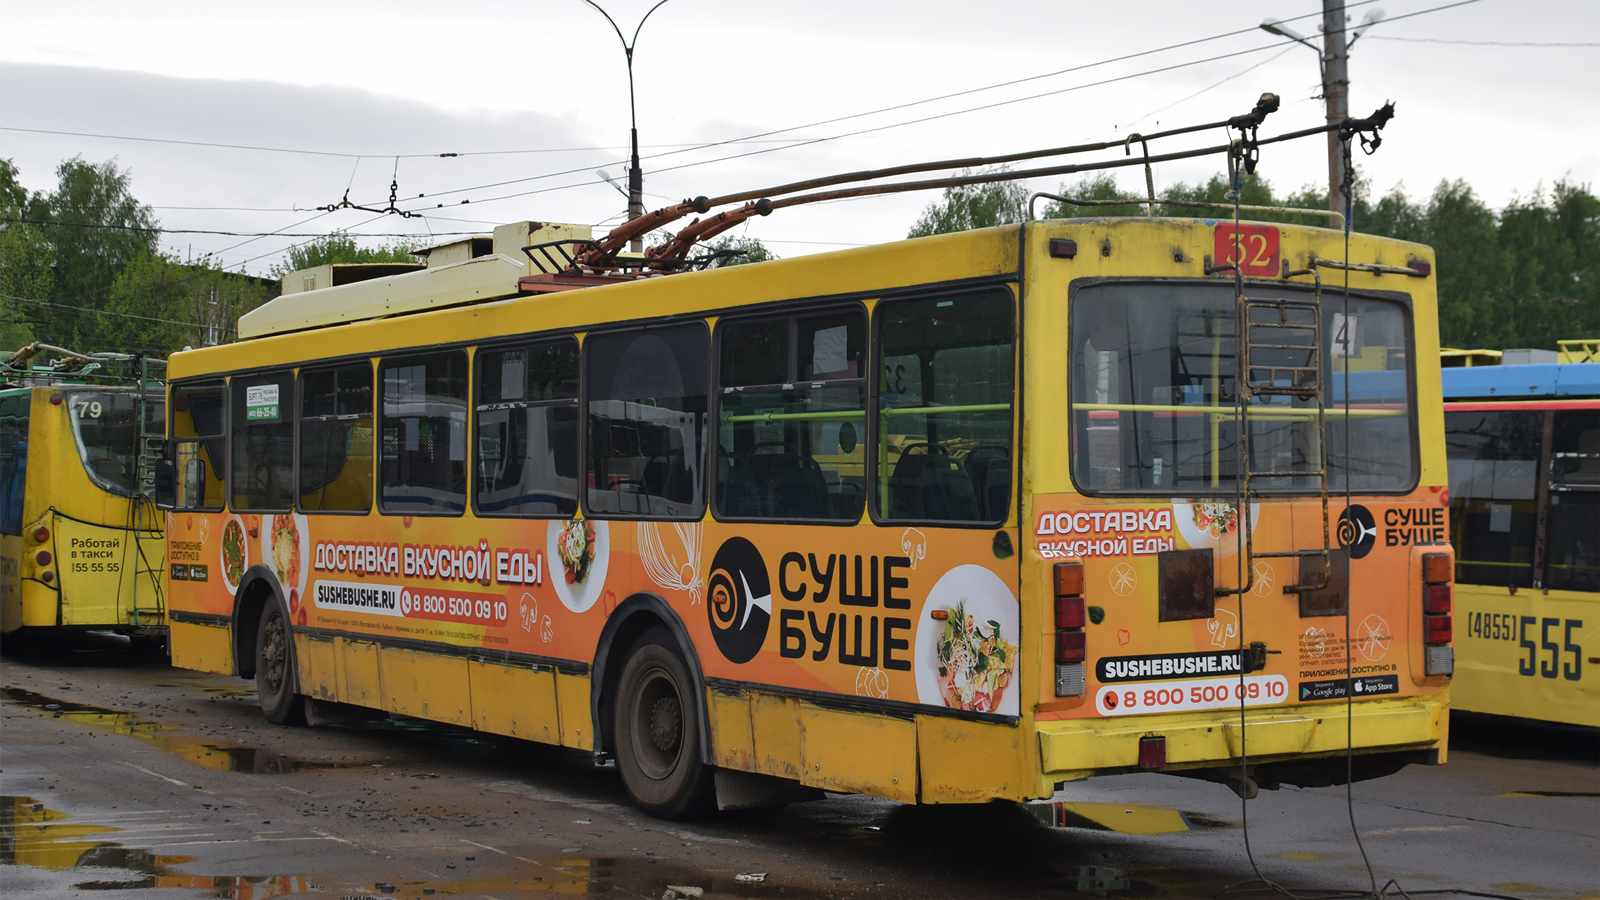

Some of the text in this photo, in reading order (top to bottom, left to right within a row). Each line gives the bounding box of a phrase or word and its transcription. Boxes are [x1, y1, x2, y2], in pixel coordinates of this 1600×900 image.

[1226, 233, 1270, 267] 32
[1335, 321, 1350, 351] 4
[78, 401, 102, 419] 79
[1037, 510, 1172, 535] ДОСТАВКА
[1384, 508, 1445, 526] СУШЕ
[71, 538, 120, 548] Работай
[171, 541, 202, 551] ПРИЛОЖЕНИЕ
[1039, 535, 1174, 558] ВКУСНОЙ ЕДЫ
[1385, 528, 1447, 546] БУШЕ
[171, 551, 200, 561] ДОСТУПНО В
[314, 542, 542, 585] ДОСТАВКА ВКУСНОЙ ЕДЫ
[779, 551, 911, 609] СУШЕ
[318, 584, 395, 609] SUSHEBUSHE.RU
[413, 594, 507, 621] 8 800 500 09 10
[780, 608, 912, 671] БУШЕ
[1519, 615, 1583, 682] 555
[1106, 654, 1241, 678] SUSHEBUSHE.RU
[1352, 664, 1390, 675] ДОСТУПНО
[1392, 663, 1397, 671] В
[1124, 680, 1285, 708] 8 800 500 09 10
[1364, 682, 1393, 693] App Store
